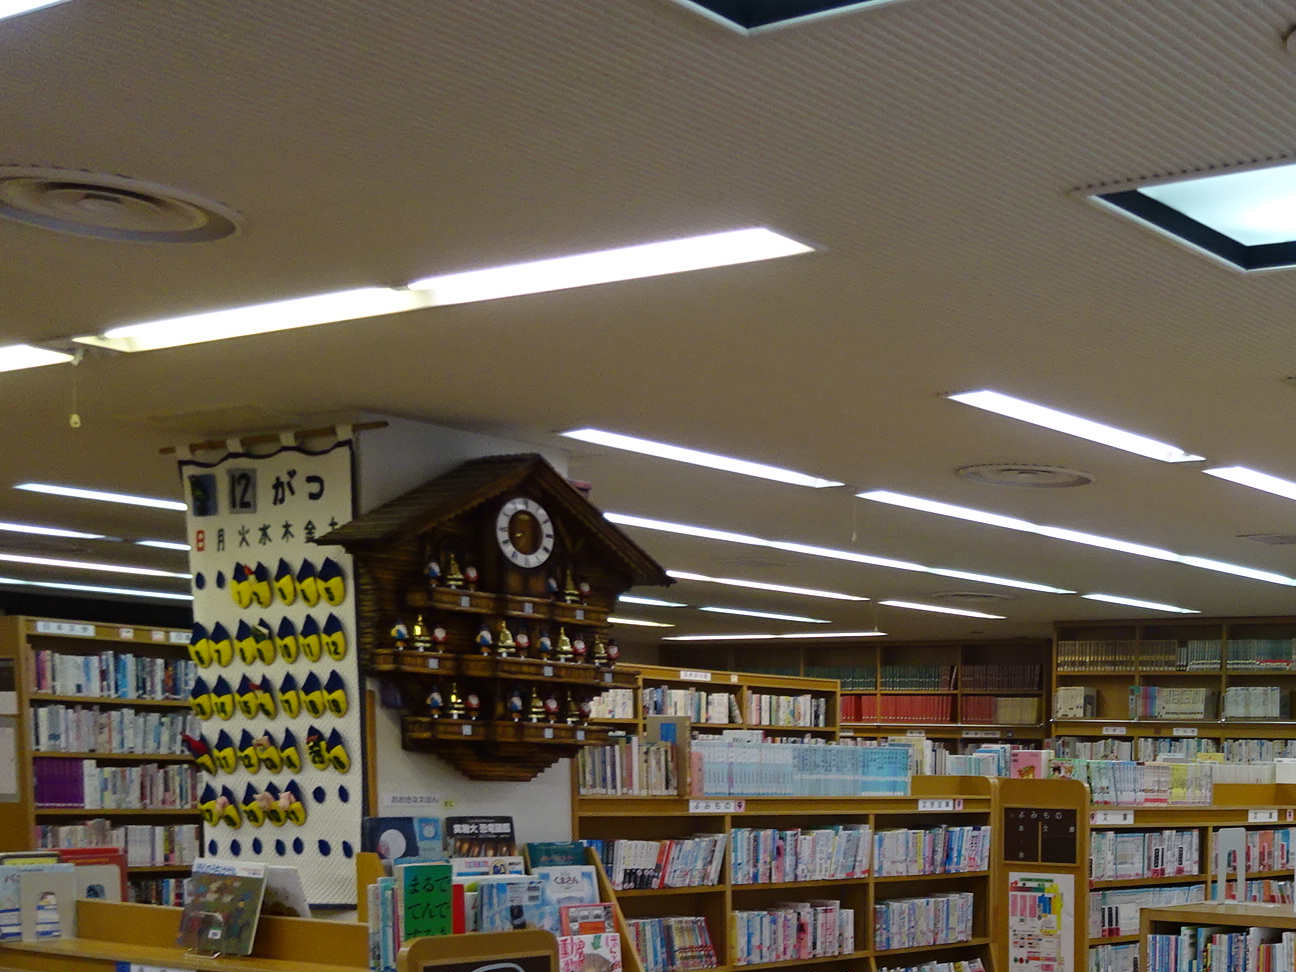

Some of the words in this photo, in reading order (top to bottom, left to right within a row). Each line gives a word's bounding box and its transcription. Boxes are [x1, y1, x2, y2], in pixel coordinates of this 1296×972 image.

[272, 469, 325, 506] がつ
[196, 530, 205, 552] 日
[217, 528, 225, 552] 月
[238, 525, 250, 547] 火
[258, 523, 272, 545] 水
[281, 520, 295, 543] 木
[410, 876, 450, 895] まるで
[408, 903, 450, 920] てんで
